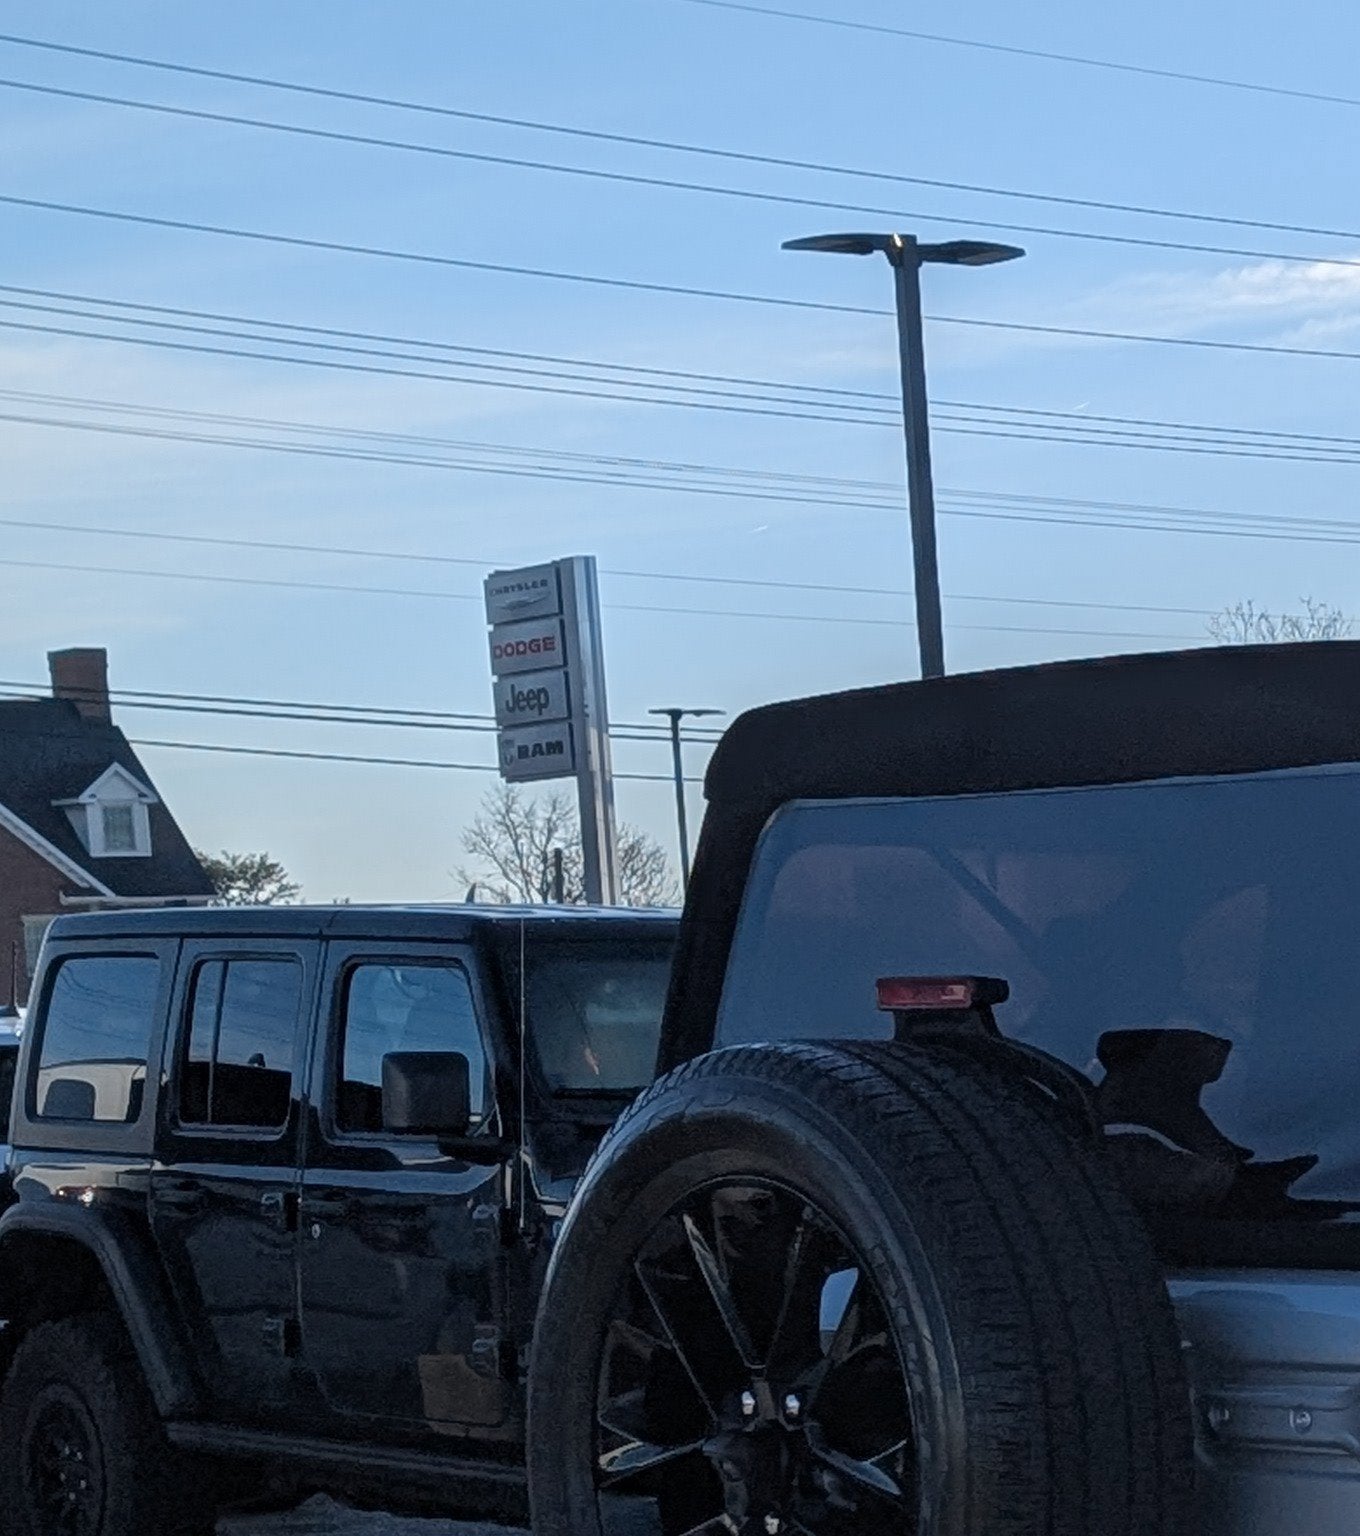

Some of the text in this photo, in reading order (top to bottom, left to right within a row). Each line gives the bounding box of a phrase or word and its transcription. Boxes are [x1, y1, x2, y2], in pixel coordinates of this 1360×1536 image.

[493, 635, 556, 660] DODGE
[505, 683, 550, 716] Jeep
[517, 740, 564, 760] RAM
